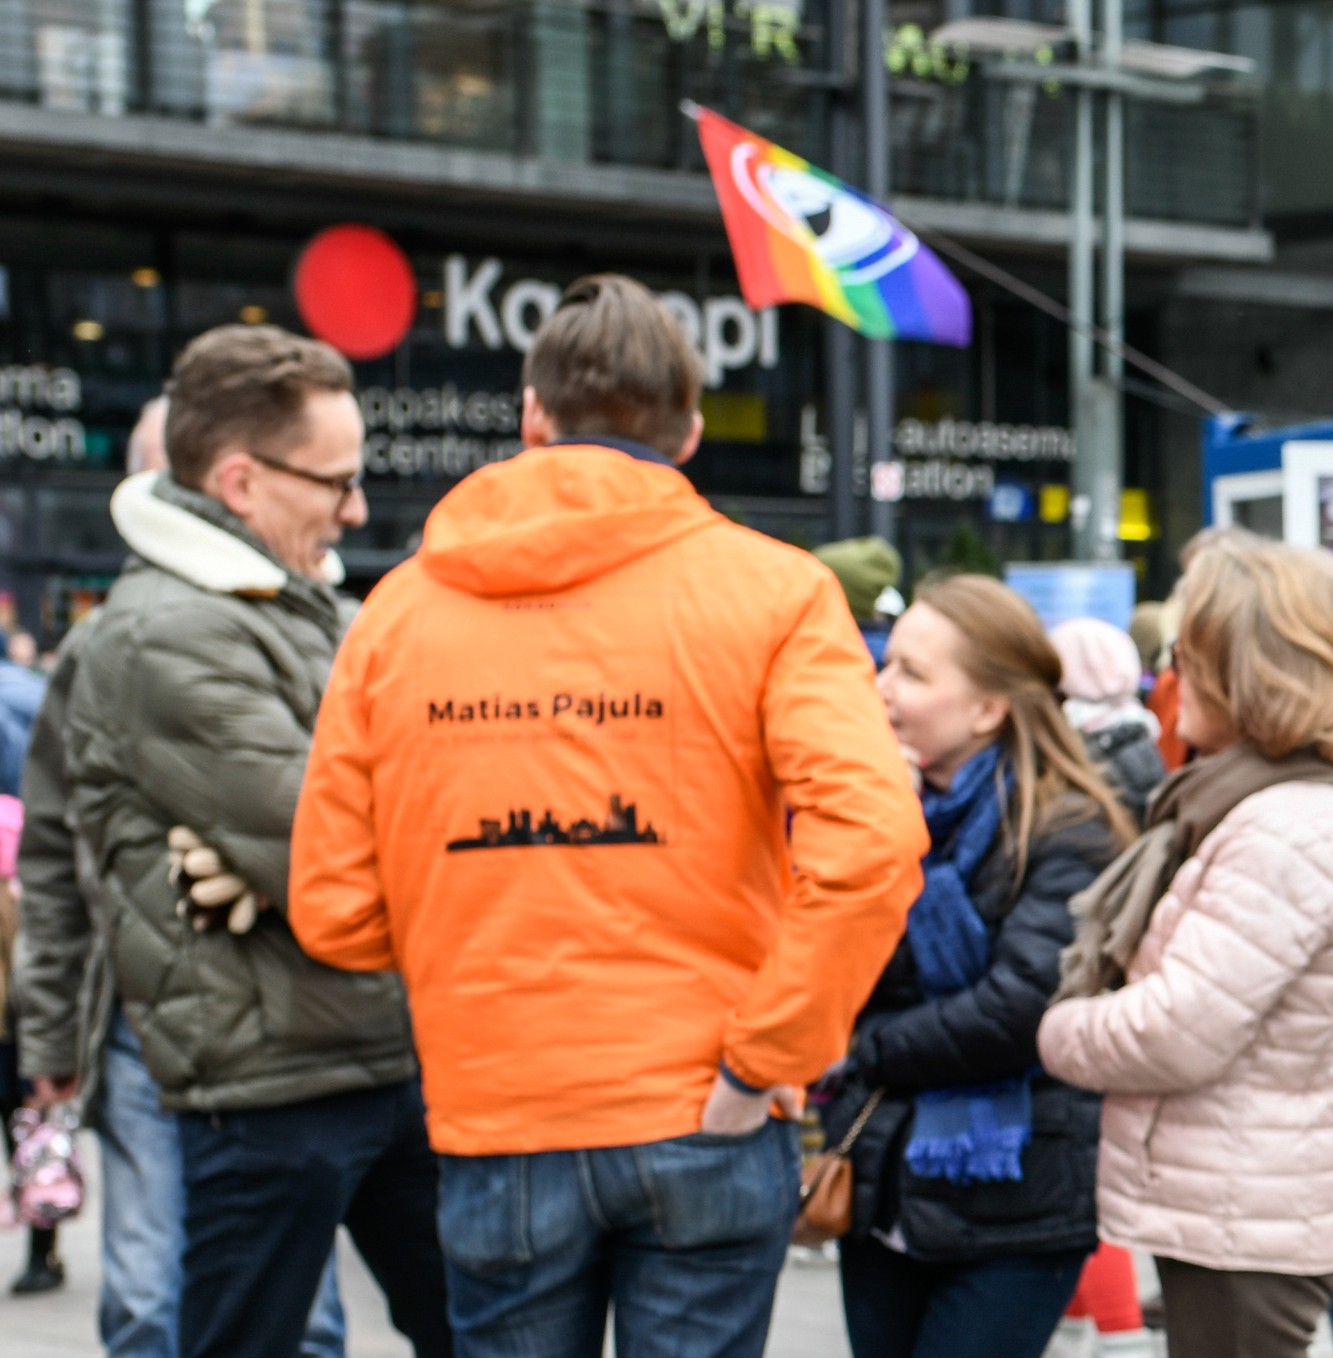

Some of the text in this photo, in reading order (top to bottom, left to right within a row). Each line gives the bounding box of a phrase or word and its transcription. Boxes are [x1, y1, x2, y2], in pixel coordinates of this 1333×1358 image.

[443, 252, 780, 388] Kapi
[428, 692, 664, 725] Matias Pajula
